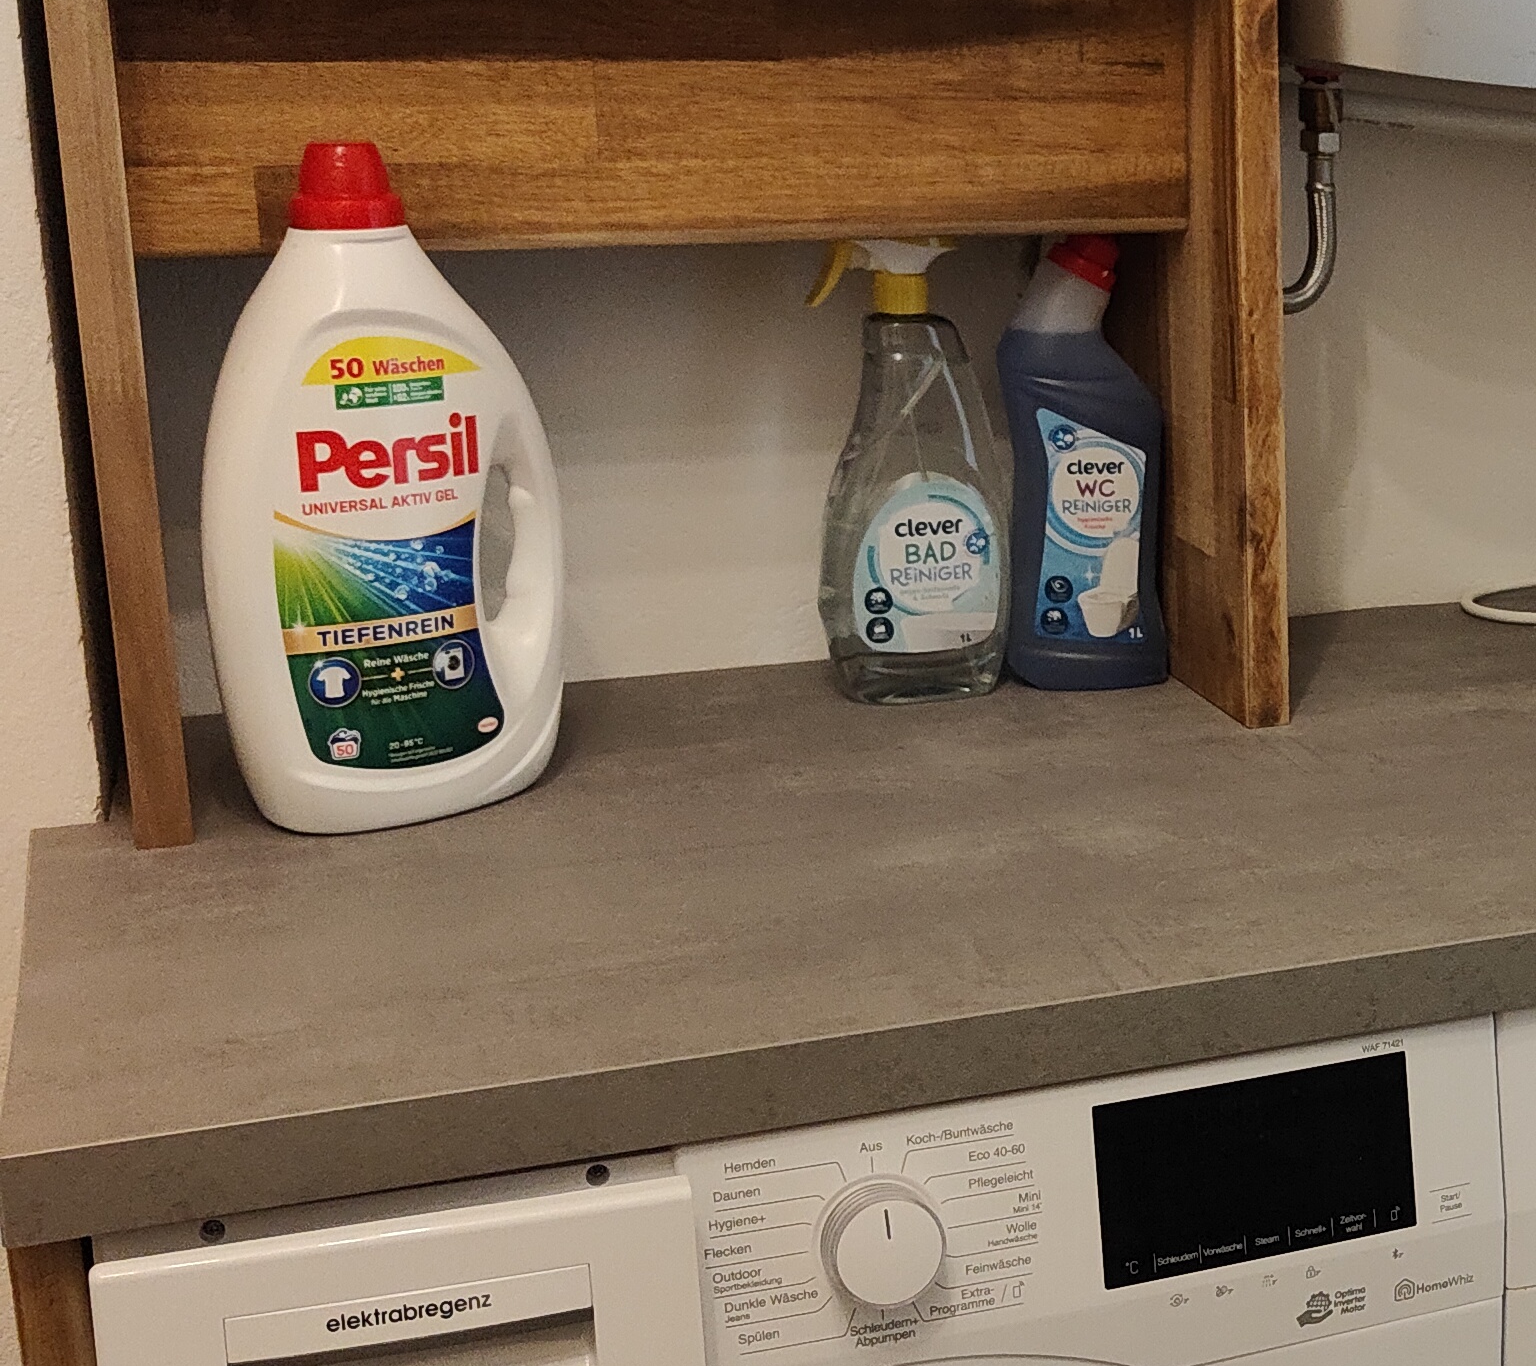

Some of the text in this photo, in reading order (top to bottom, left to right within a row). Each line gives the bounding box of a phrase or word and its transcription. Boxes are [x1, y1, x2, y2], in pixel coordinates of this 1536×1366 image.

[330, 355, 446, 380] 50 Wäschen
[296, 412, 480, 493] Persil
[1067, 459, 1125, 475] clever
[1076, 479, 1116, 498] WC
[302, 488, 459, 516] UNIVERSAL AKTIV GEL
[894, 519, 963, 537] clever
[905, 540, 957, 565] BAD
[316, 613, 455, 647] TIEFENREIN
[363, 651, 430, 669] Reine Wäsche
[336, 743, 355, 757] 50
[1361, 1039, 1404, 1053] WAF 71421
[907, 1120, 1014, 1146] Koch-/Buntwäsche
[859, 1142, 883, 1153] Aus
[968, 1143, 1026, 1161] Eco 40-60
[724, 1158, 776, 1174] Hemden
[968, 1169, 1034, 1189] Pflegeleicht
[713, 1187, 761, 1203] Daunen
[1018, 1190, 1041, 1203] Mini
[1013, 1205, 1030, 1214] Mini
[1440, 1202, 1463, 1212] Pause
[708, 1215, 767, 1232] Hygiene+
[1006, 1220, 1037, 1234] Wolle
[1340, 1213, 1367, 1225] Zeitvor-
[1345, 1223, 1363, 1233] wahl
[987, 1233, 1038, 1247] Handwäsche
[1254, 1235, 1280, 1246] Steam
[704, 1243, 752, 1260] Flecken
[1202, 1242, 1243, 1257] Vorwäsche
[965, 1255, 1032, 1275] Feinwäsche
[1157, 1251, 1199, 1266] Schleudern
[713, 1267, 762, 1284] Outdoor
[713, 1276, 783, 1294] Sportbekleidung
[961, 1286, 995, 1300] Extra-
[724, 1289, 819, 1314] Dunkle Wäsche
[930, 1296, 996, 1316] Programme
[1334, 1295, 1366, 1308] Inverter
[1340, 1303, 1366, 1315] Motor
[326, 1292, 492, 1333] elektrabregenz
[724, 1312, 750, 1323] Jeans
[850, 1317, 919, 1336] Schleudern+
[738, 1329, 780, 1346] Spülen
[855, 1327, 916, 1349] Abpumpen
